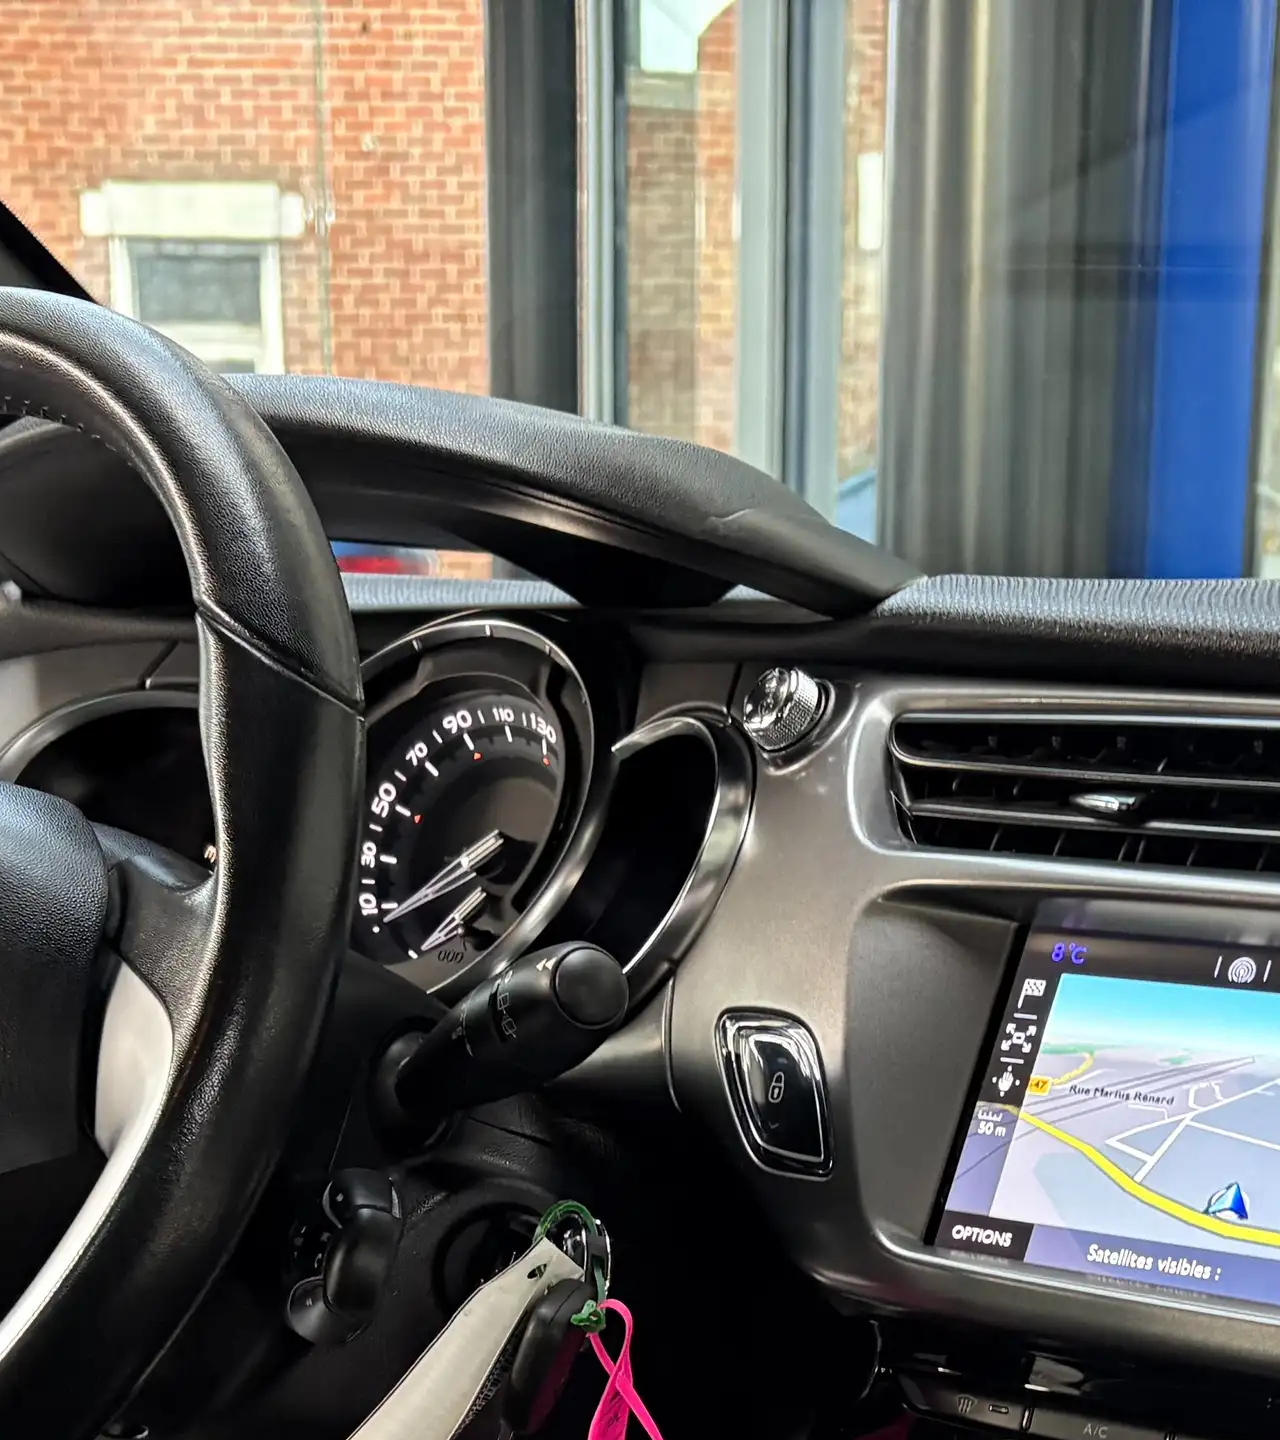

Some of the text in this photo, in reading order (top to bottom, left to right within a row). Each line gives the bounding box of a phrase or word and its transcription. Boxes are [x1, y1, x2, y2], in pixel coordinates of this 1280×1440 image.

[443, 709, 472, 734] 90
[492, 708, 514, 722] 110
[530, 713, 556, 743] 130
[405, 742, 428, 766] 70
[371, 782, 397, 818] 50
[361, 841, 377, 868] 30
[359, 893, 379, 917] 10
[1070, 1084, 1091, 1097] Rue
[977, 1121, 1006, 1137] 50 m
[951, 1224, 1013, 1248] OPTIONS
[1086, 1244, 1153, 1270] Satellites
[1157, 1257, 1212, 1280] visibles
[1083, 1423, 1108, 1439] A/C
